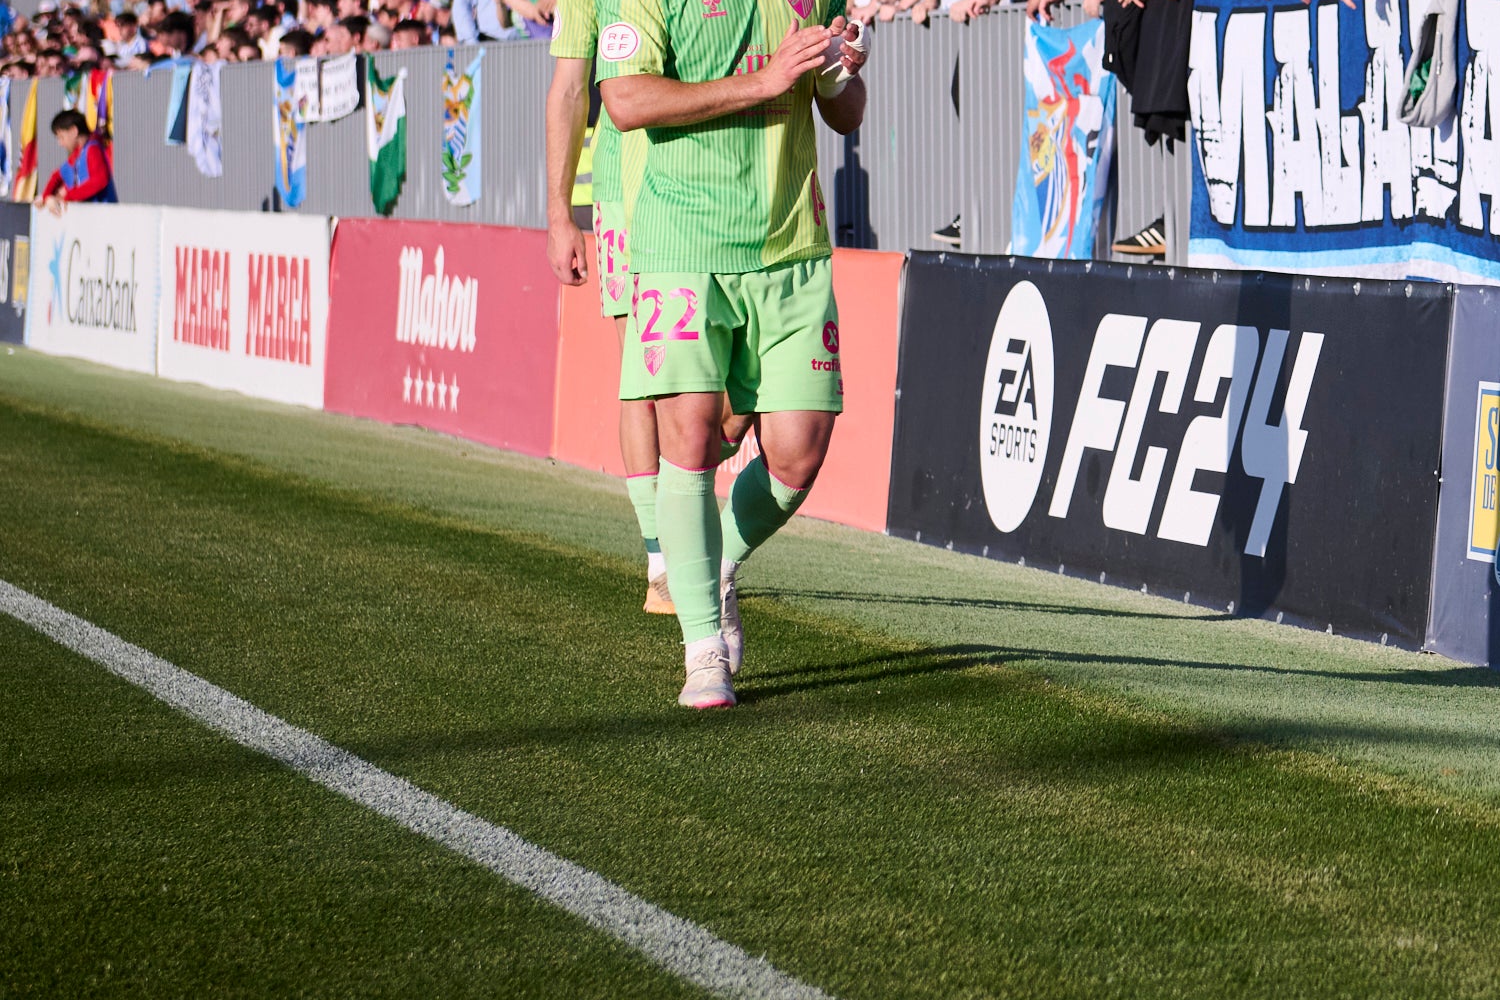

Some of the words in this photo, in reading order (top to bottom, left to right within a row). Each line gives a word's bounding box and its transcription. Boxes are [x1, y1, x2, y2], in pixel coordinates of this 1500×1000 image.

[66, 238, 138, 333] CaixaBank
[173, 246, 231, 353] MARCA
[246, 252, 312, 367] MARCA
[396, 244, 479, 354] Mahou
[640, 287, 699, 343] 22
[994, 338, 1038, 421] EA
[990, 422, 1038, 463] SPORTS
[1482, 474, 1497, 511] DE
